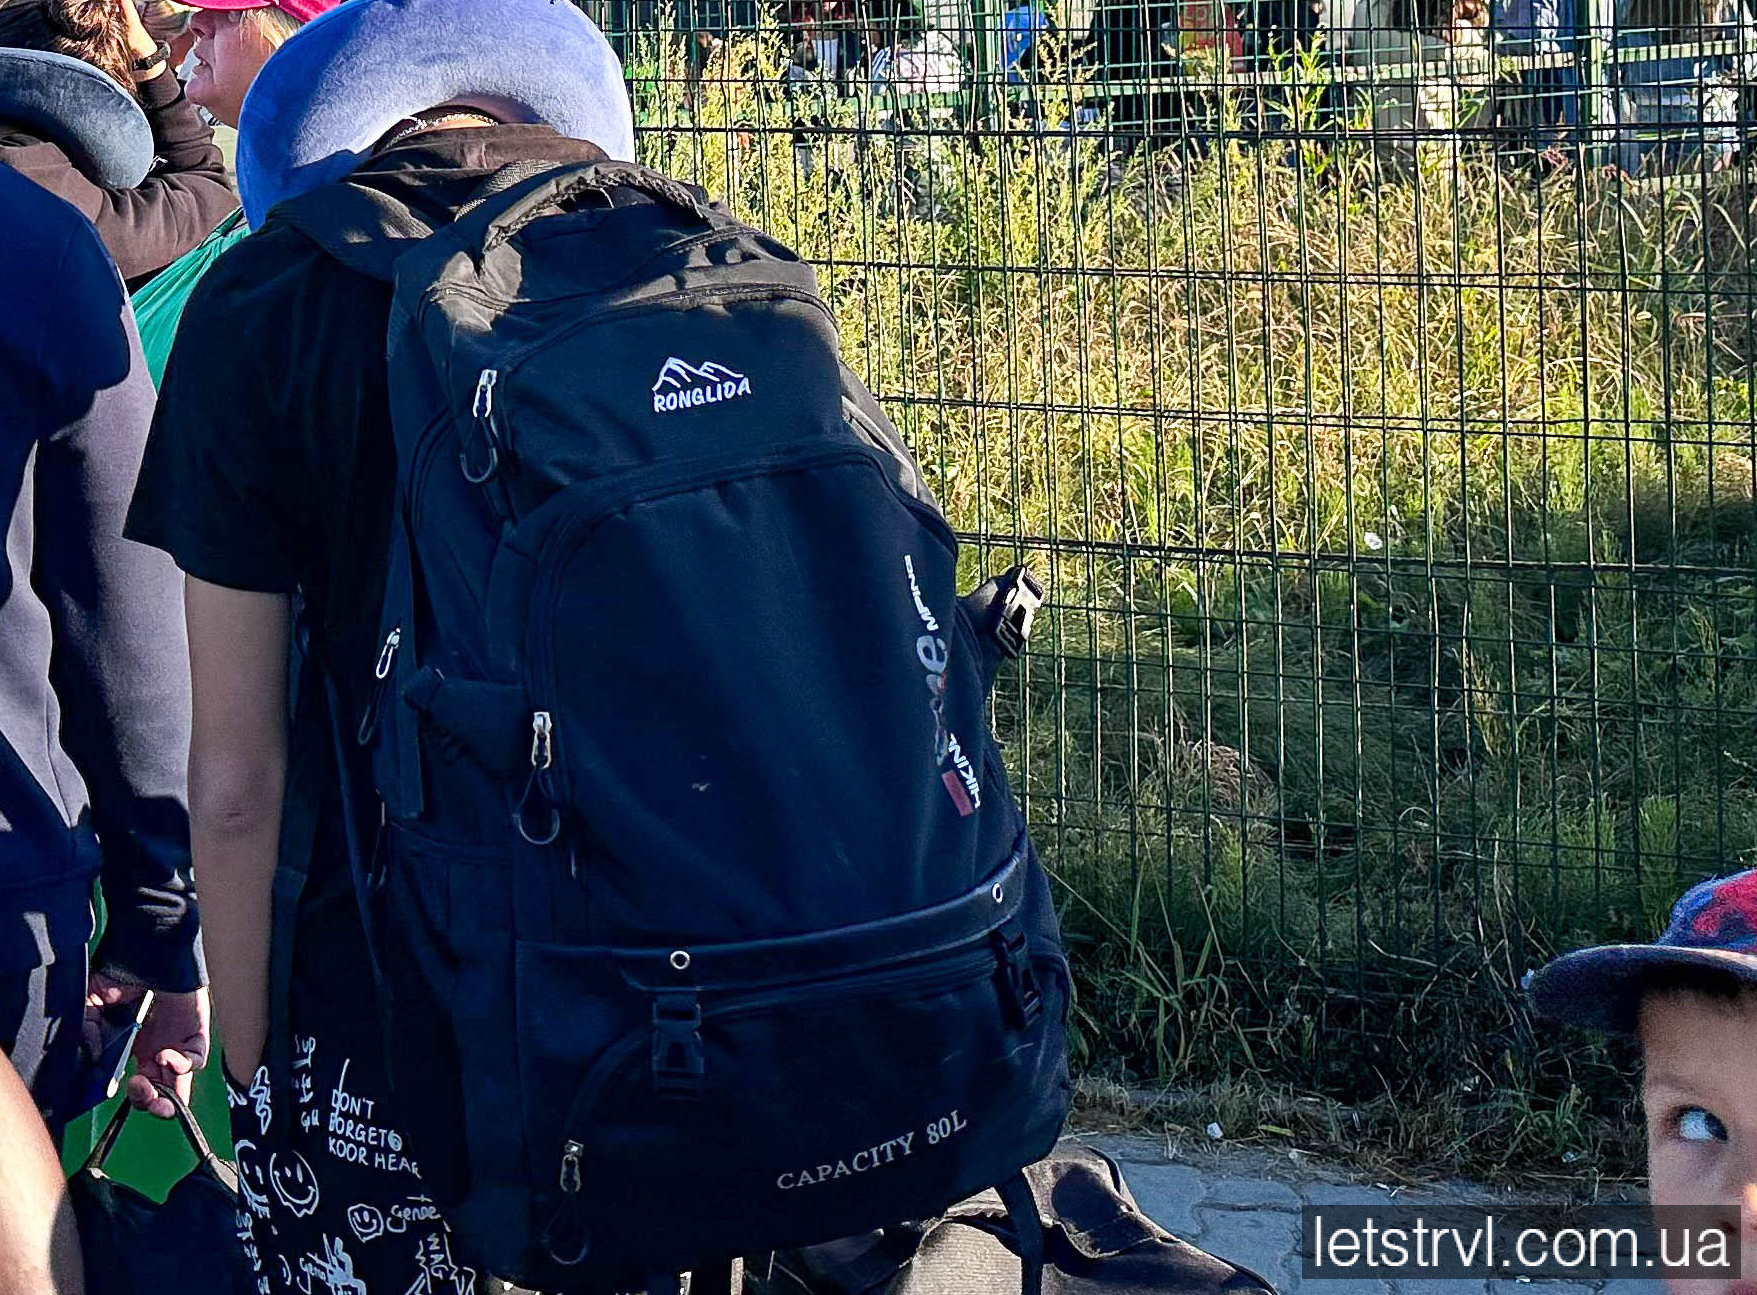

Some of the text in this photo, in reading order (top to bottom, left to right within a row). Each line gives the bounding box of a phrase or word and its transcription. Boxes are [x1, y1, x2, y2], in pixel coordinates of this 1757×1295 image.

[653, 376, 752, 413] RONGLIDA
[331, 1088, 375, 1119] DON'T
[776, 1109, 968, 1189] CAPACITY 80L
